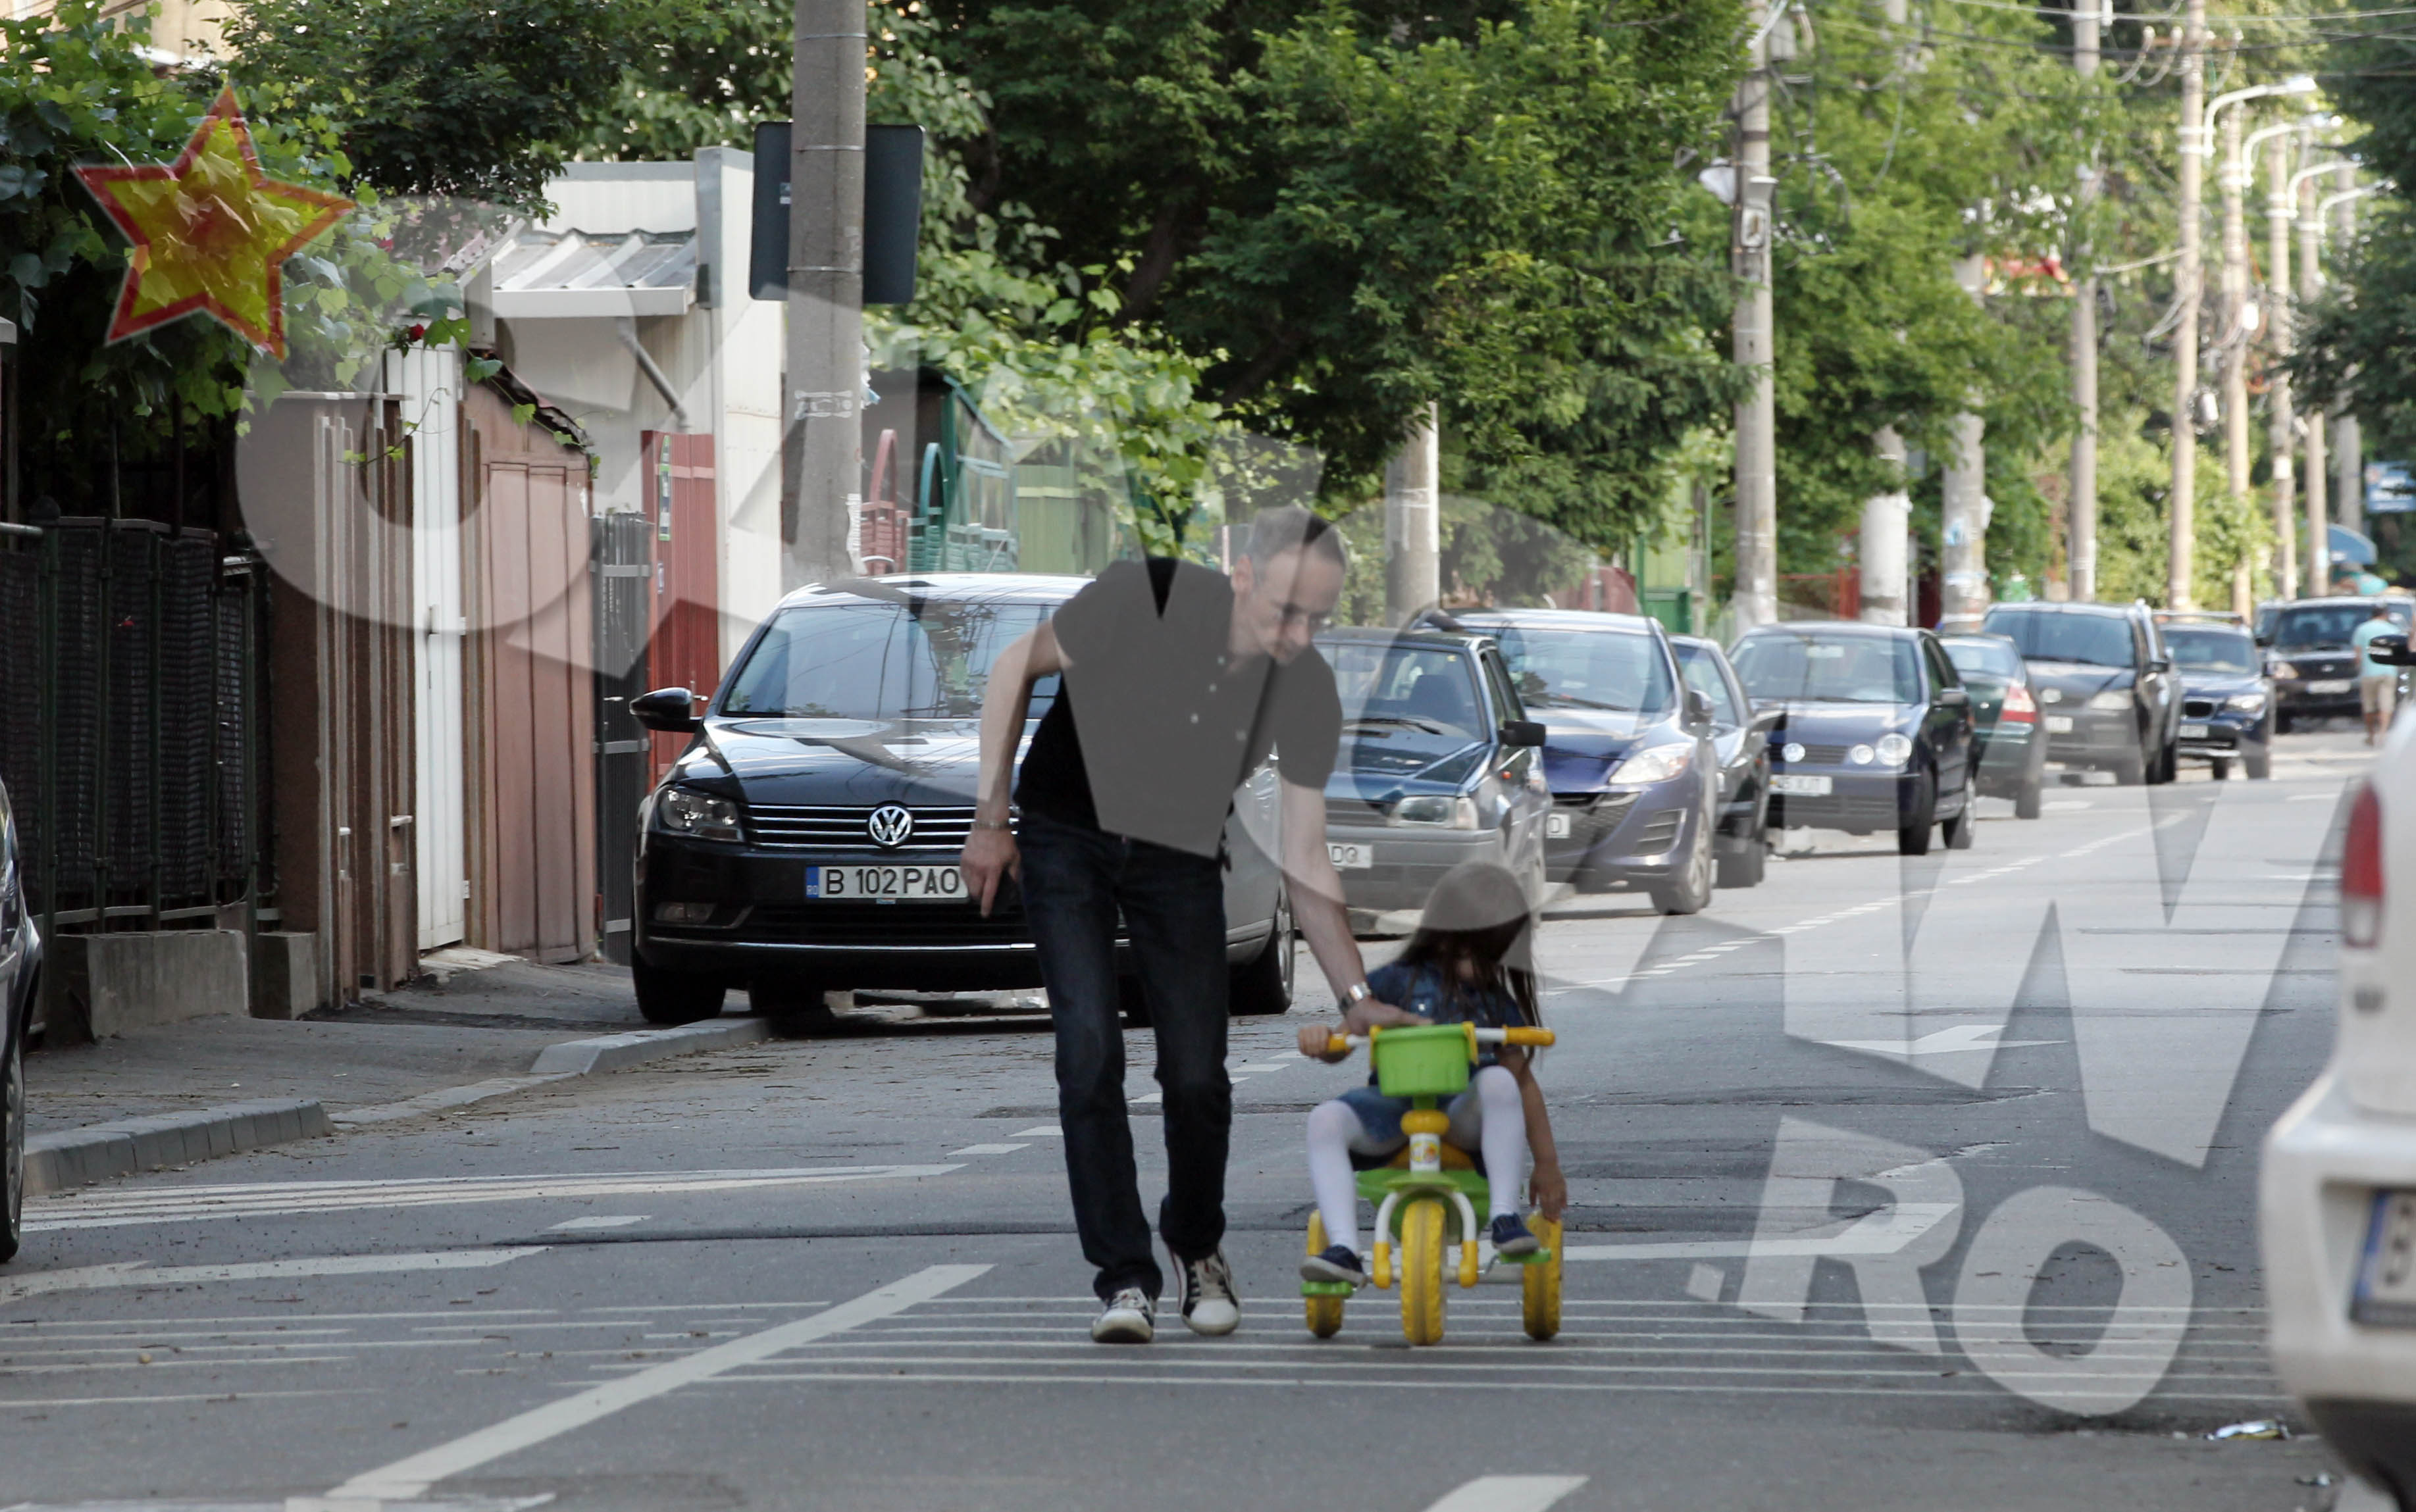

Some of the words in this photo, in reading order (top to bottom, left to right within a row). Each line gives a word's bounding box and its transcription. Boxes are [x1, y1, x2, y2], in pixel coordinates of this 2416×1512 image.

[825, 869, 844, 895] B
[856, 868, 897, 894] 102
[903, 867, 960, 894] PAO
